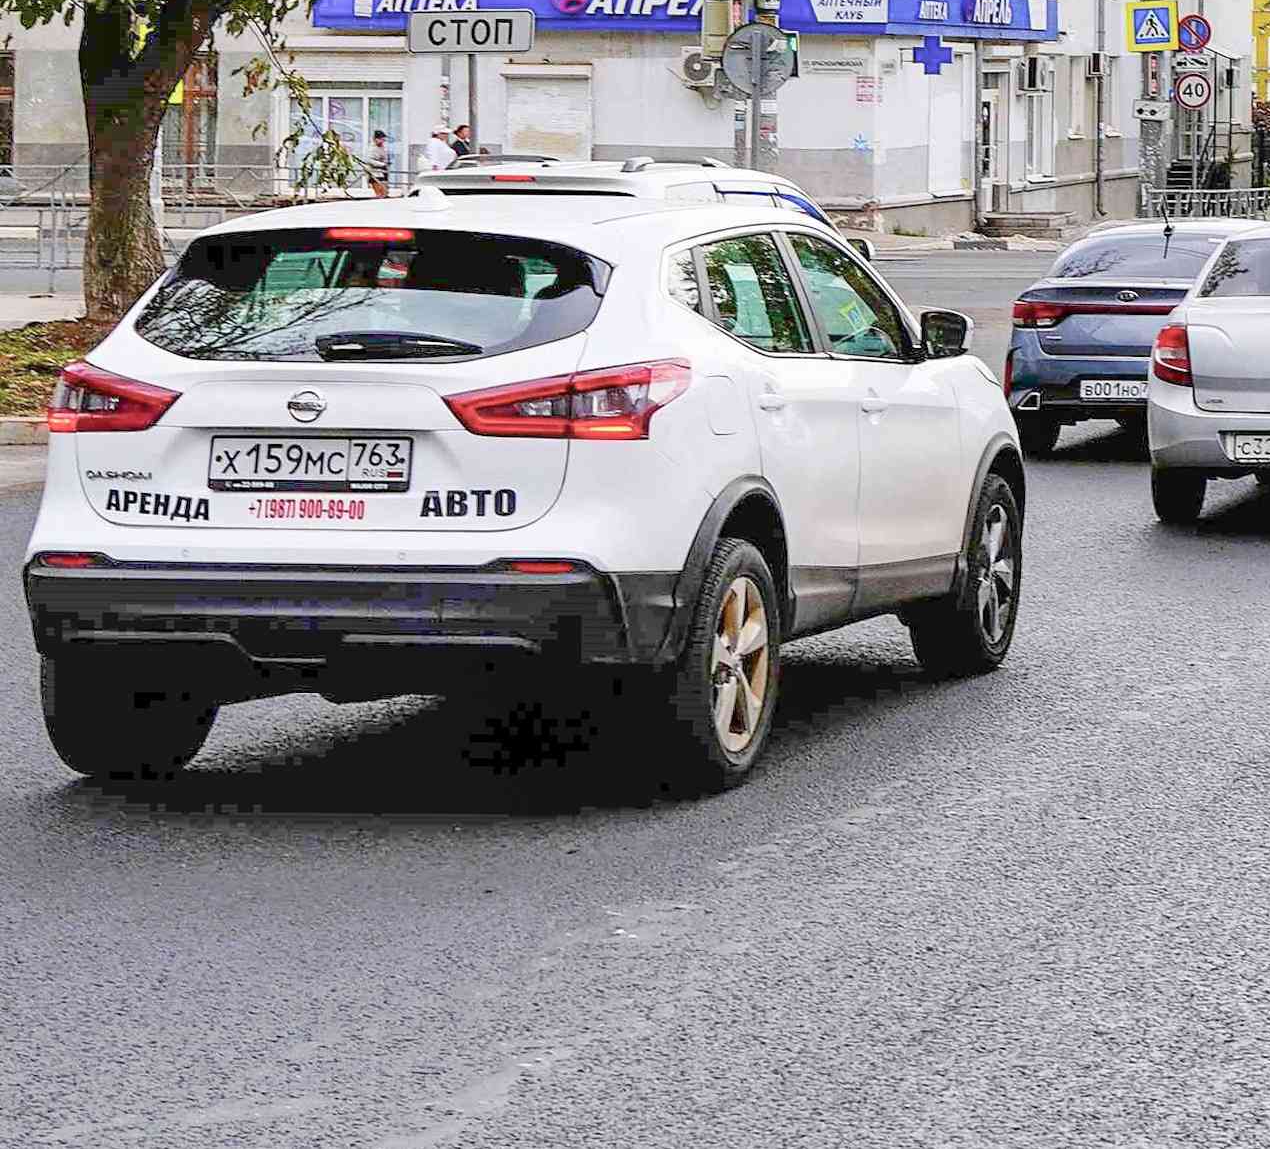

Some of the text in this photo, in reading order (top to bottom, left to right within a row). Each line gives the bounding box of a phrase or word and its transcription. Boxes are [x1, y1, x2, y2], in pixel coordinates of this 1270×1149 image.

[835, 11, 864, 20] КЛУБ
[428, 19, 514, 45] СТОП
[1182, 83, 1205, 98] 40
[353, 443, 401, 467] 763
[361, 468, 386, 478] RUS
[106, 488, 516, 522] АРЕНДА АВТО
